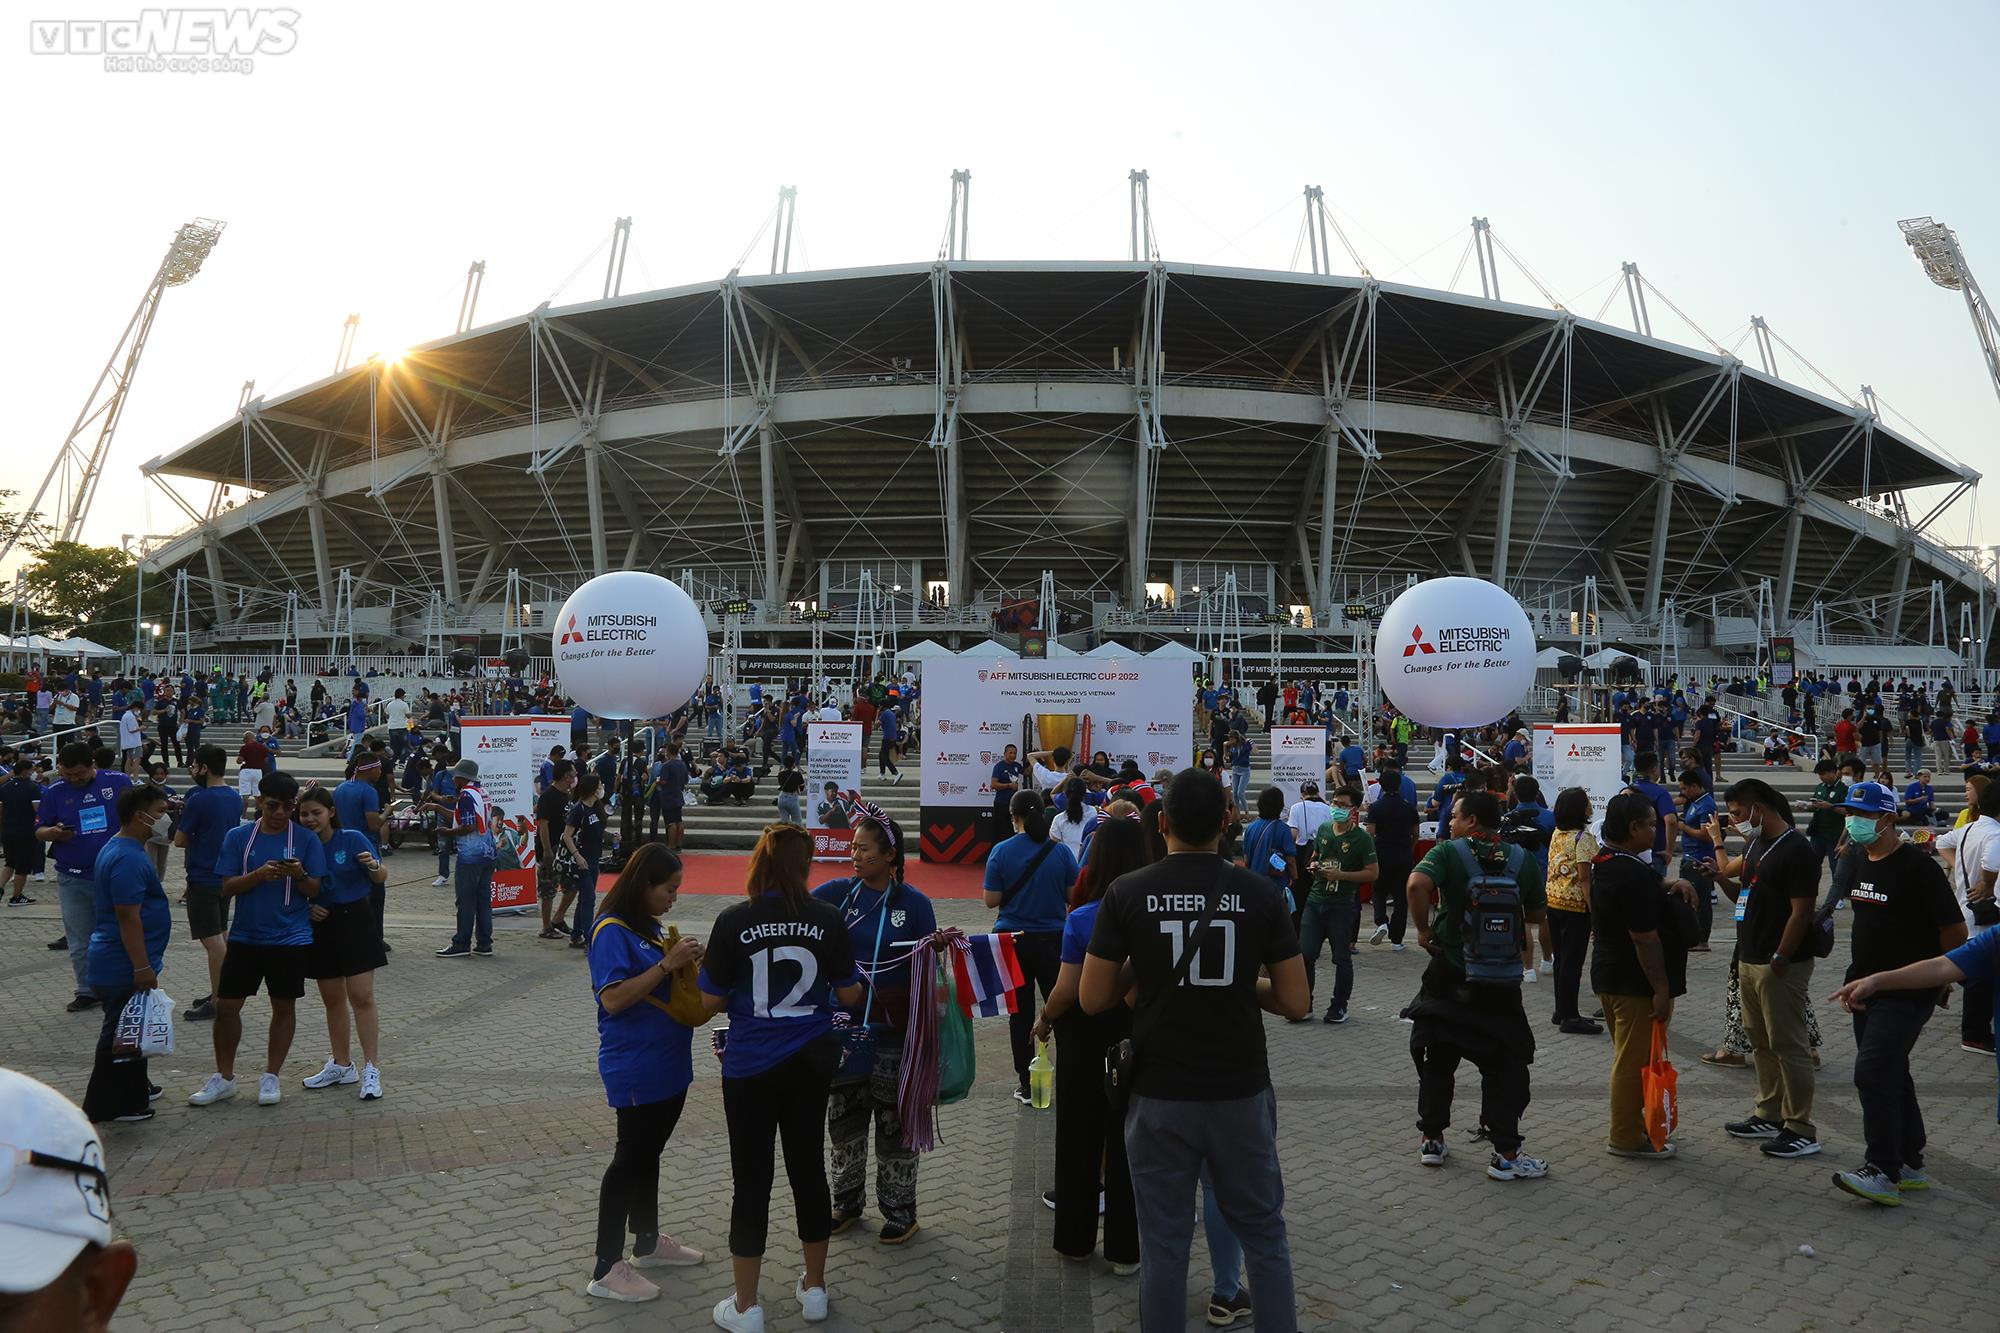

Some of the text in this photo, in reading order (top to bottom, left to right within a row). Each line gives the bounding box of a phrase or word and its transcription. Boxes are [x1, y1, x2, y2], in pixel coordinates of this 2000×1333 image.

[587, 614, 657, 627] MITSUBISHI
[587, 629, 647, 641] ELECTRIC
[1439, 627, 1510, 640] MITSUBISHI
[1439, 640, 1502, 653] ELECTRIC
[560, 646, 657, 661] Changes for the Better
[762, 662, 799, 670] MITSUBISHI
[831, 662, 846, 670] CUP
[1293, 666, 1324, 674] ELECTRIC
[1403, 658, 1511, 674] Changes for the Better
[990, 672, 1139, 681] AFF MITSUBISHI ELECTRIC CUP 2022
[1860, 882, 1875, 891] THE
[1850, 889, 1888, 902] STANDARD
[1146, 894, 1245, 913] D.TEERSIL
[739, 922, 825, 944] CHEERTHAI
[1159, 919, 1236, 987] 10
[749, 945, 818, 1018] 12
